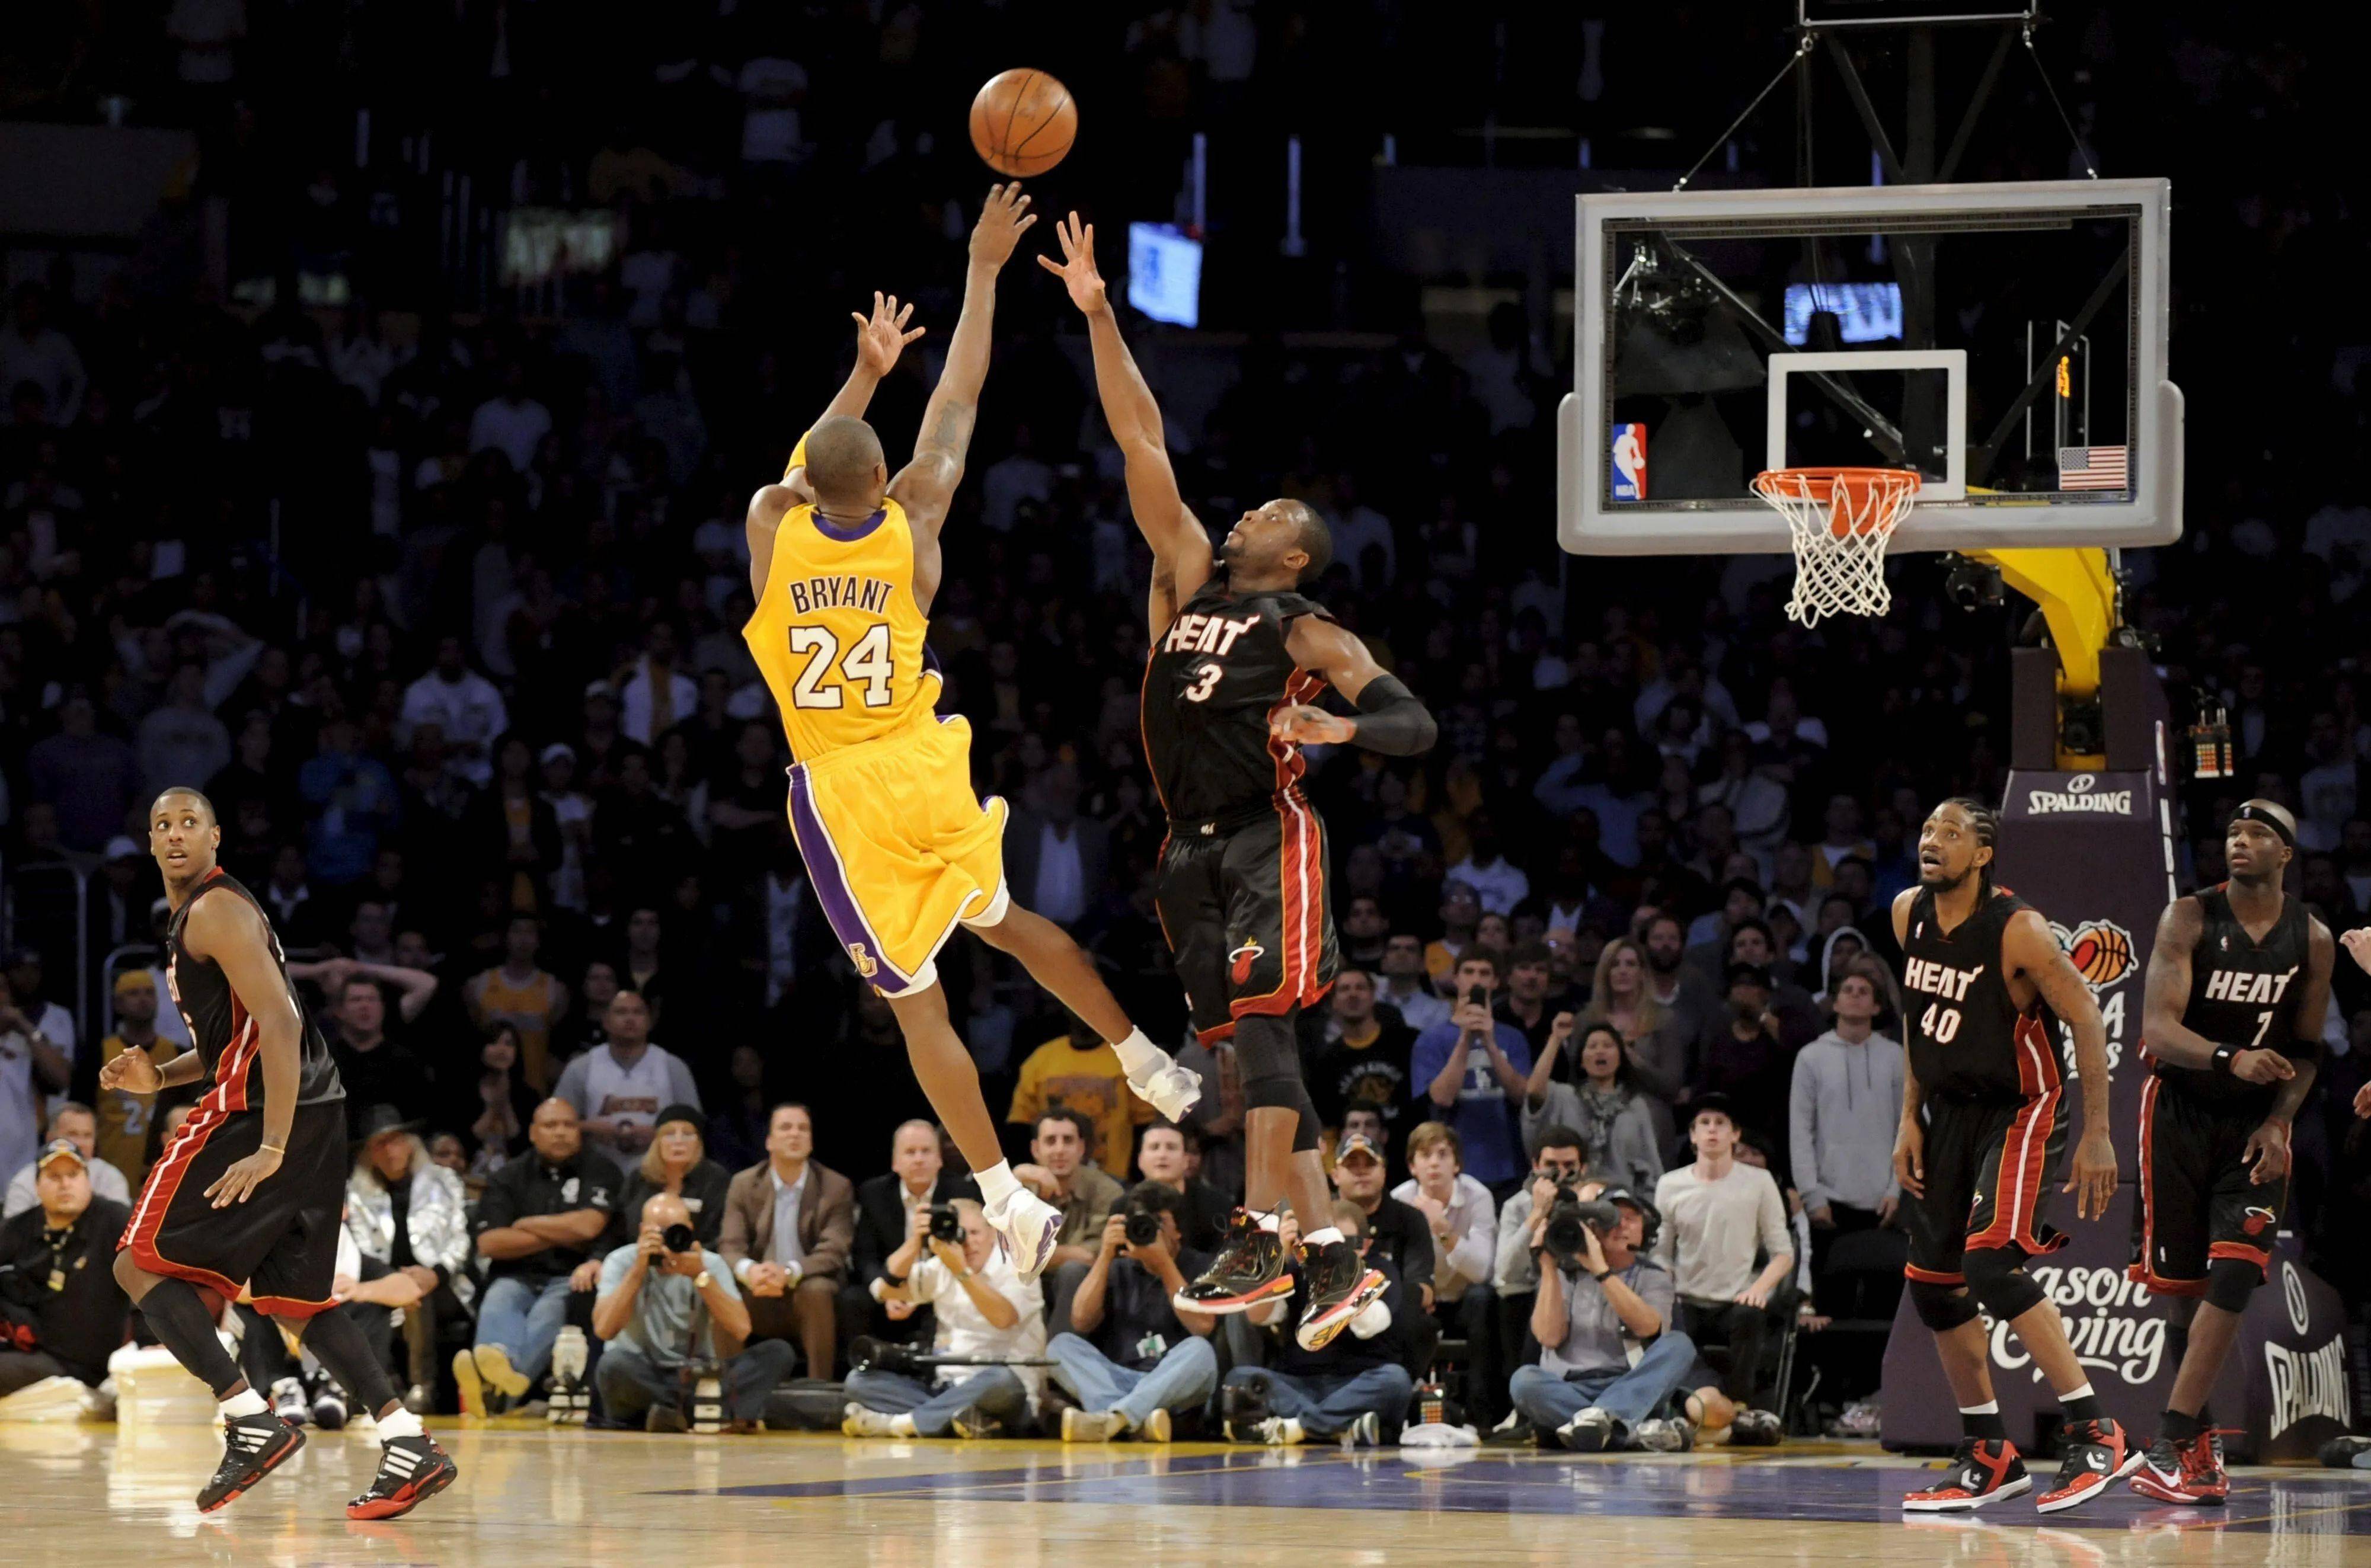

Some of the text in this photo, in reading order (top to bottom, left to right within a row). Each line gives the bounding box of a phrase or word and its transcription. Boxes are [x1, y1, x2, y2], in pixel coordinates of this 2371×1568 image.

[788, 576, 894, 616] BRYANT
[1164, 614, 1261, 656] HEAT
[788, 623, 894, 709] 24
[1186, 663, 1223, 703] 3
[2027, 790, 2132, 815] SPALDING
[1904, 956, 1985, 1003] HEAT
[2205, 965, 2300, 1004] HEAT
[1920, 1003, 1962, 1045] 40
[2251, 1011, 2274, 1047] 7
[2022, 1266, 2153, 1308] ason
[1990, 1307, 2167, 1384] Gving
[2264, 1333, 2351, 1441] SPALDING
